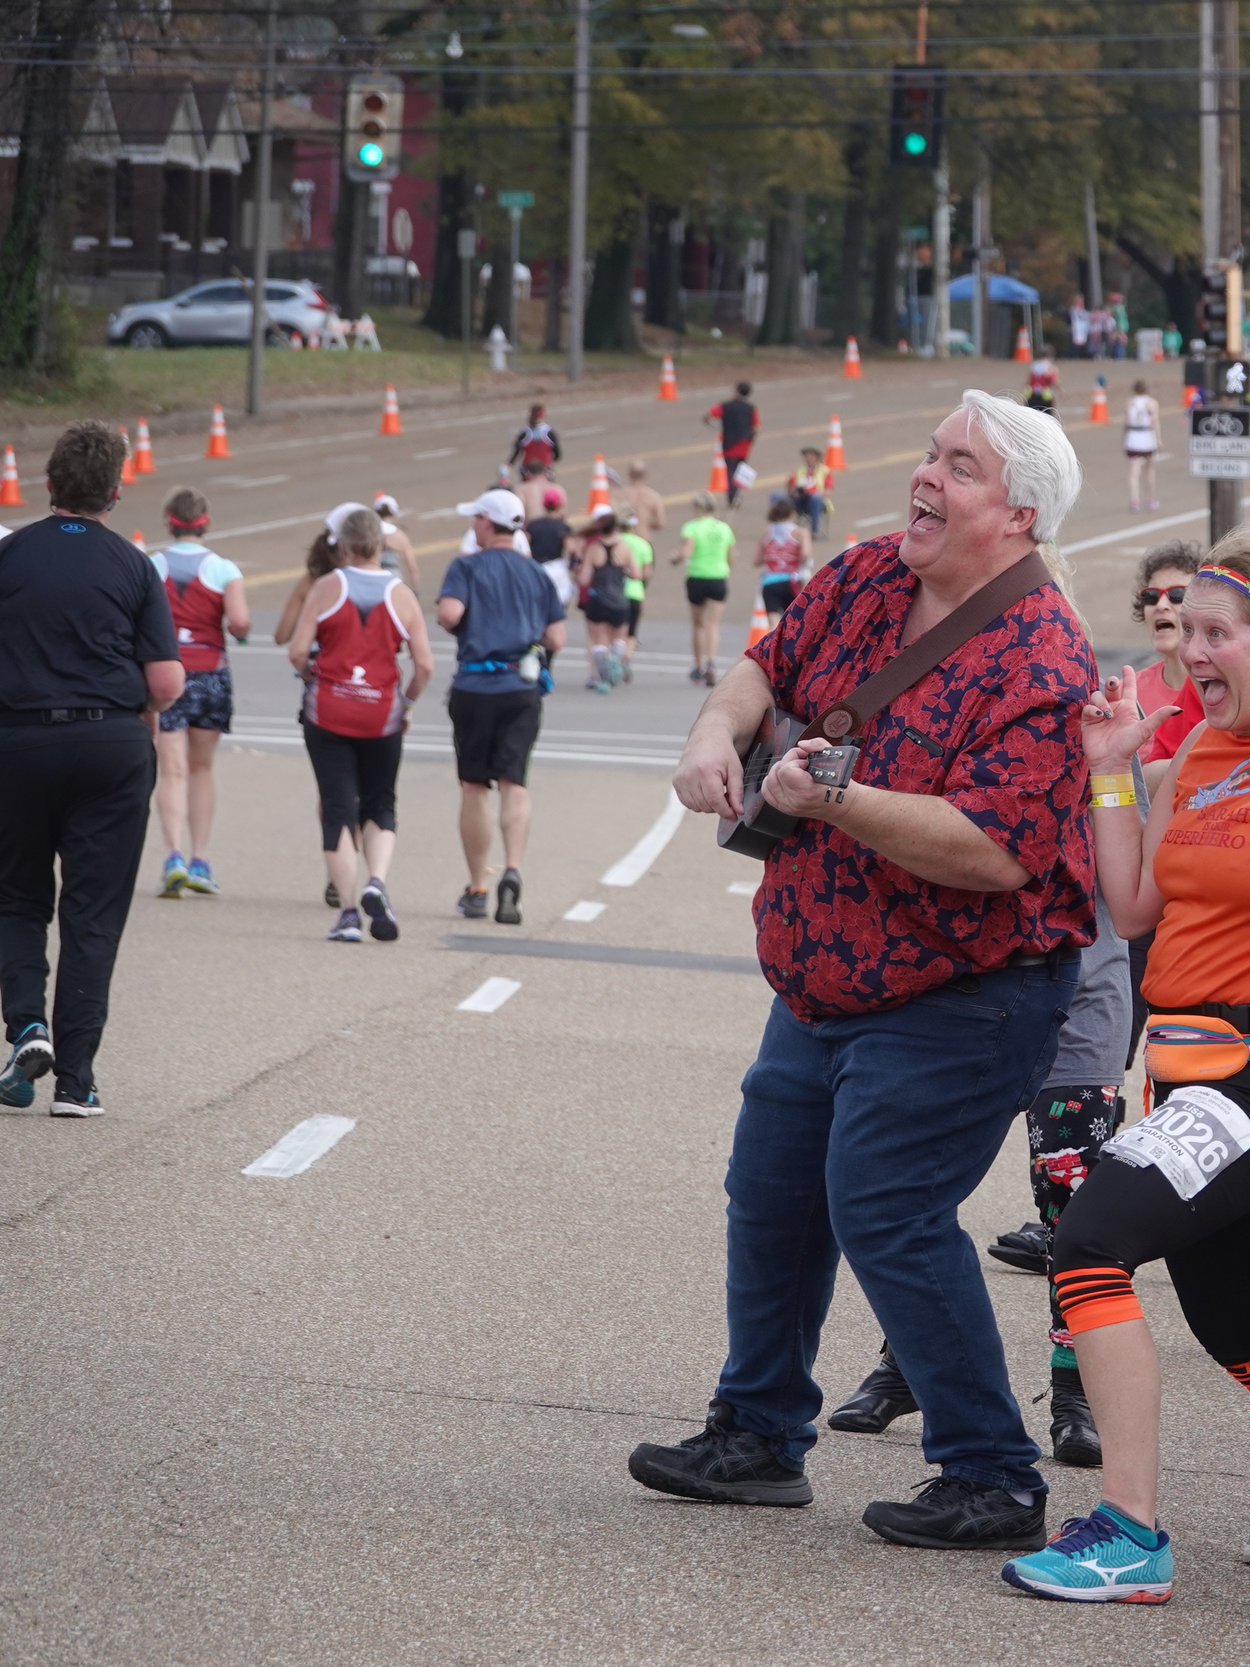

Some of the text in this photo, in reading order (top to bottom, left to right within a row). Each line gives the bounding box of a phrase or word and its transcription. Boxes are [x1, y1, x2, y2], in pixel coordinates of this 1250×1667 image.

[1198, 807, 1250, 824] SARAH
[1162, 829, 1246, 850] SUPERHERO
[1182, 1102, 1205, 1118] Lisa
[1132, 1106, 1229, 1173] 0026
[1140, 1127, 1184, 1157] MARATHON
